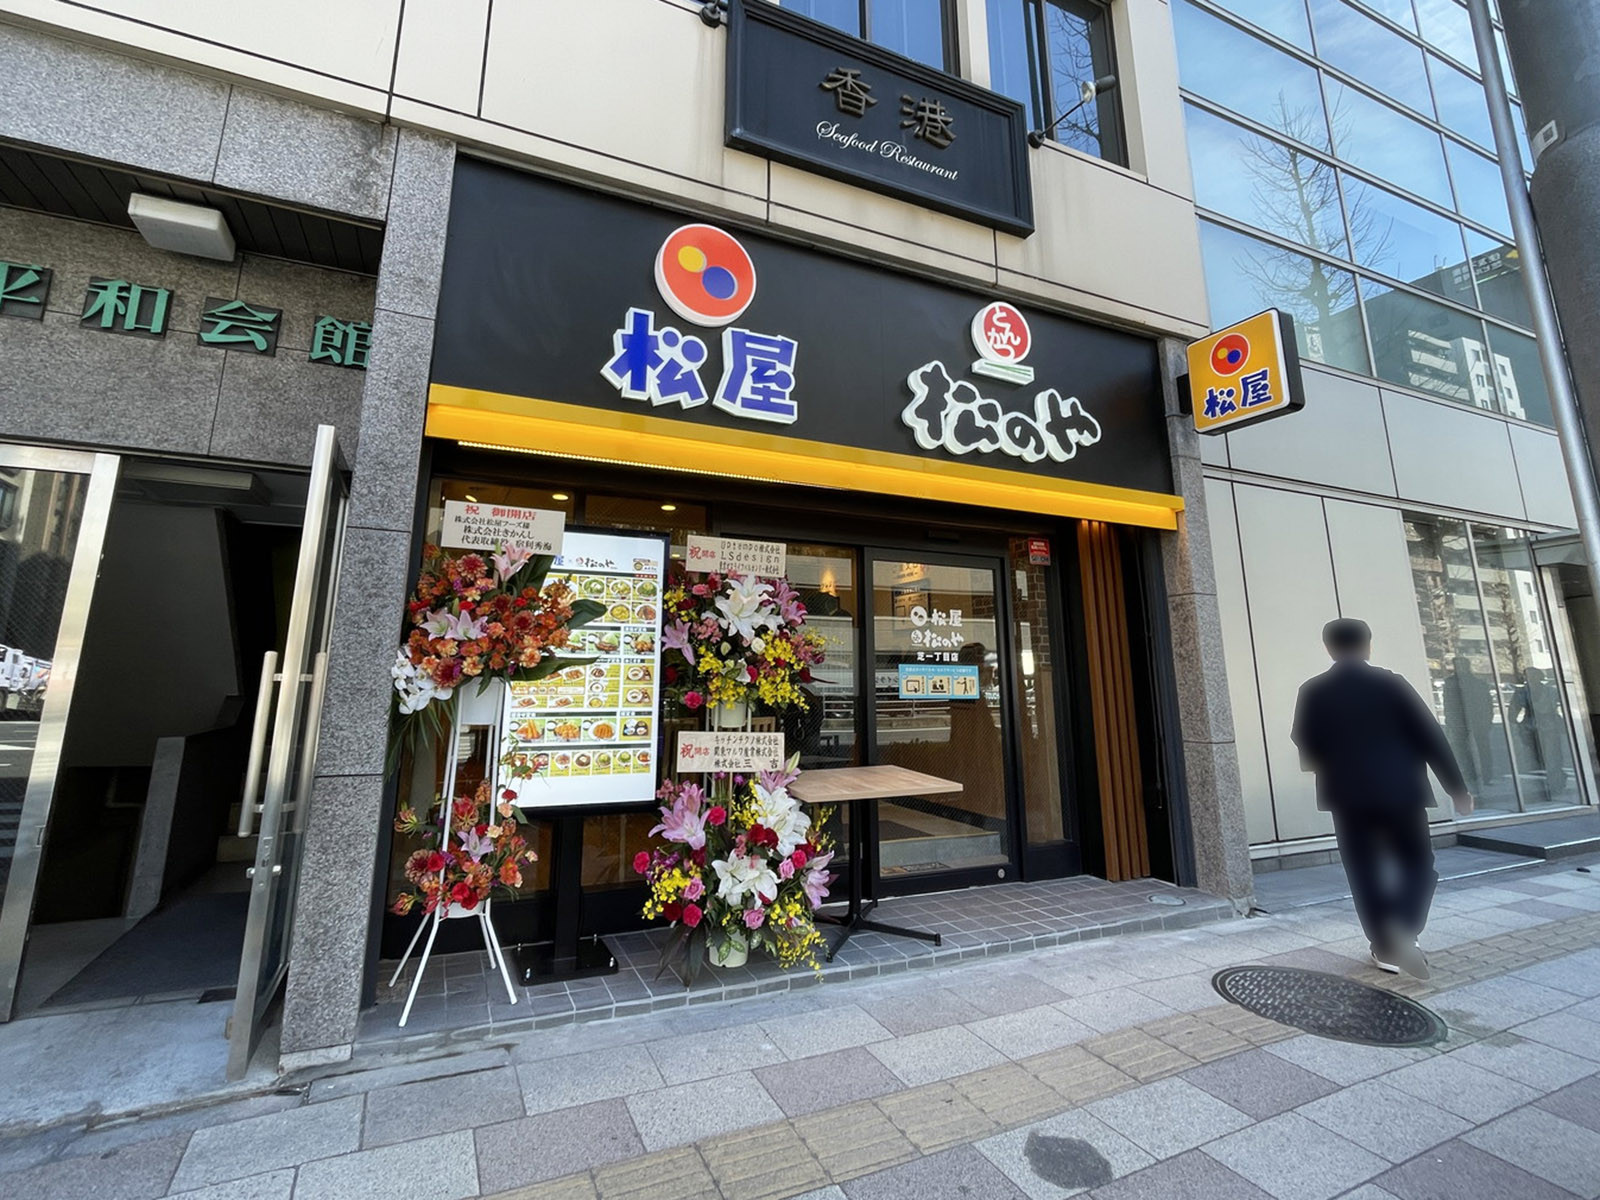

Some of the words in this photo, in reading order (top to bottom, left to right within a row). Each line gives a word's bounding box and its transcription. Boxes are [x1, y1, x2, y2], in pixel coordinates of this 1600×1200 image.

[819, 67, 956, 148] 香港
[816, 121, 877, 153] Seafood
[880, 141, 959, 181] Restaurant
[601, 307, 798, 424] 松屋
[1204, 368, 1273, 418] 松屋
[901, 360, 1101, 463] 松のや
[465, 504, 480, 515] 祝
[491, 507, 537, 520] 御開店
[930, 608, 963, 627] 松屋
[916, 651, 959, 662] 芝一丁目店
